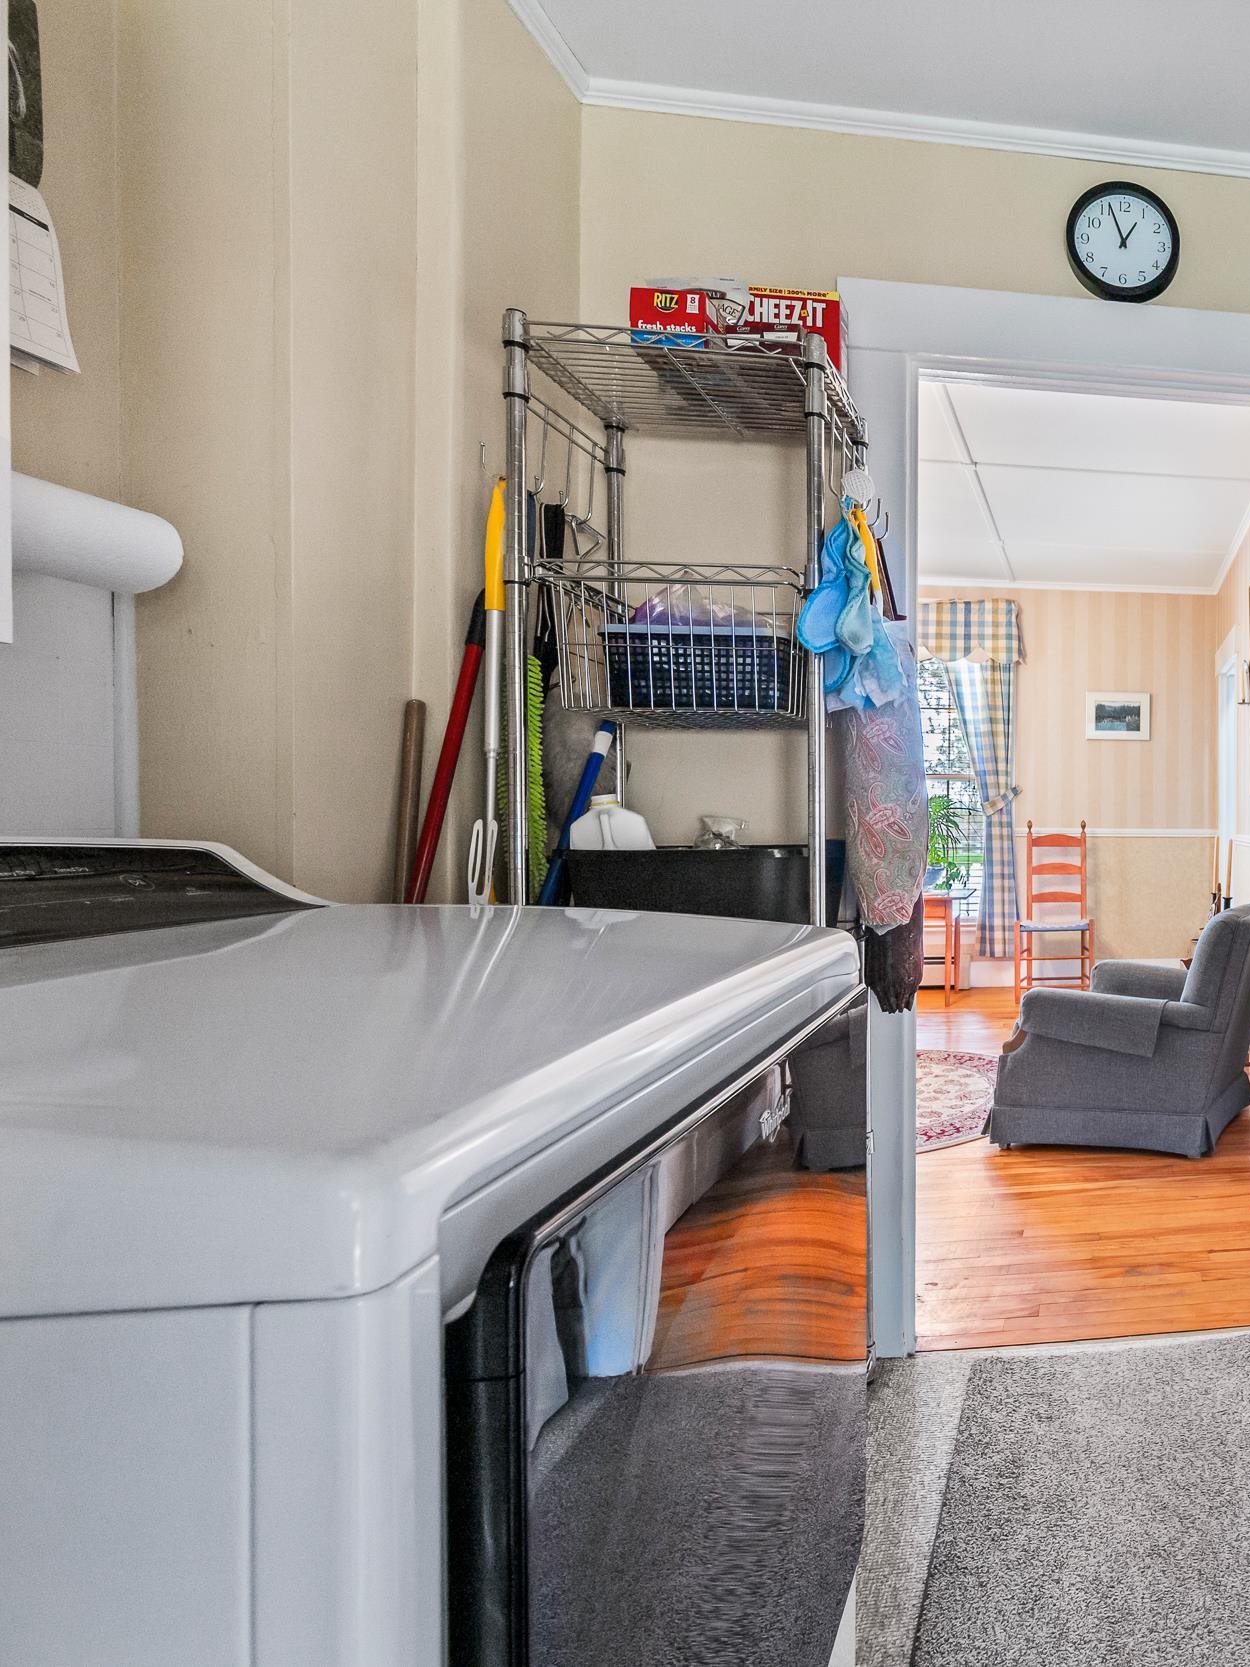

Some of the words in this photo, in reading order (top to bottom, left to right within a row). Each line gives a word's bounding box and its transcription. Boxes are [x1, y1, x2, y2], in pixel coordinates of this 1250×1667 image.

[1119, 201, 1131, 213] 12
[1087, 217, 1102, 229] 10
[1153, 222, 1161, 234] 2
[1080, 232, 1090, 245] 9
[1157, 242, 1166, 253] 3
[1085, 251, 1095, 263] 8
[1151, 260, 1160, 271] 4
[1100, 266, 1108, 278] 7
[1137, 270, 1147, 282] 5
[1118, 273, 1127, 285] 6
[653, 292, 679, 309] RITZ
[690, 296, 697, 304] 8
[638, 319, 664, 331] fresh
[666, 322, 697, 333] stacks
